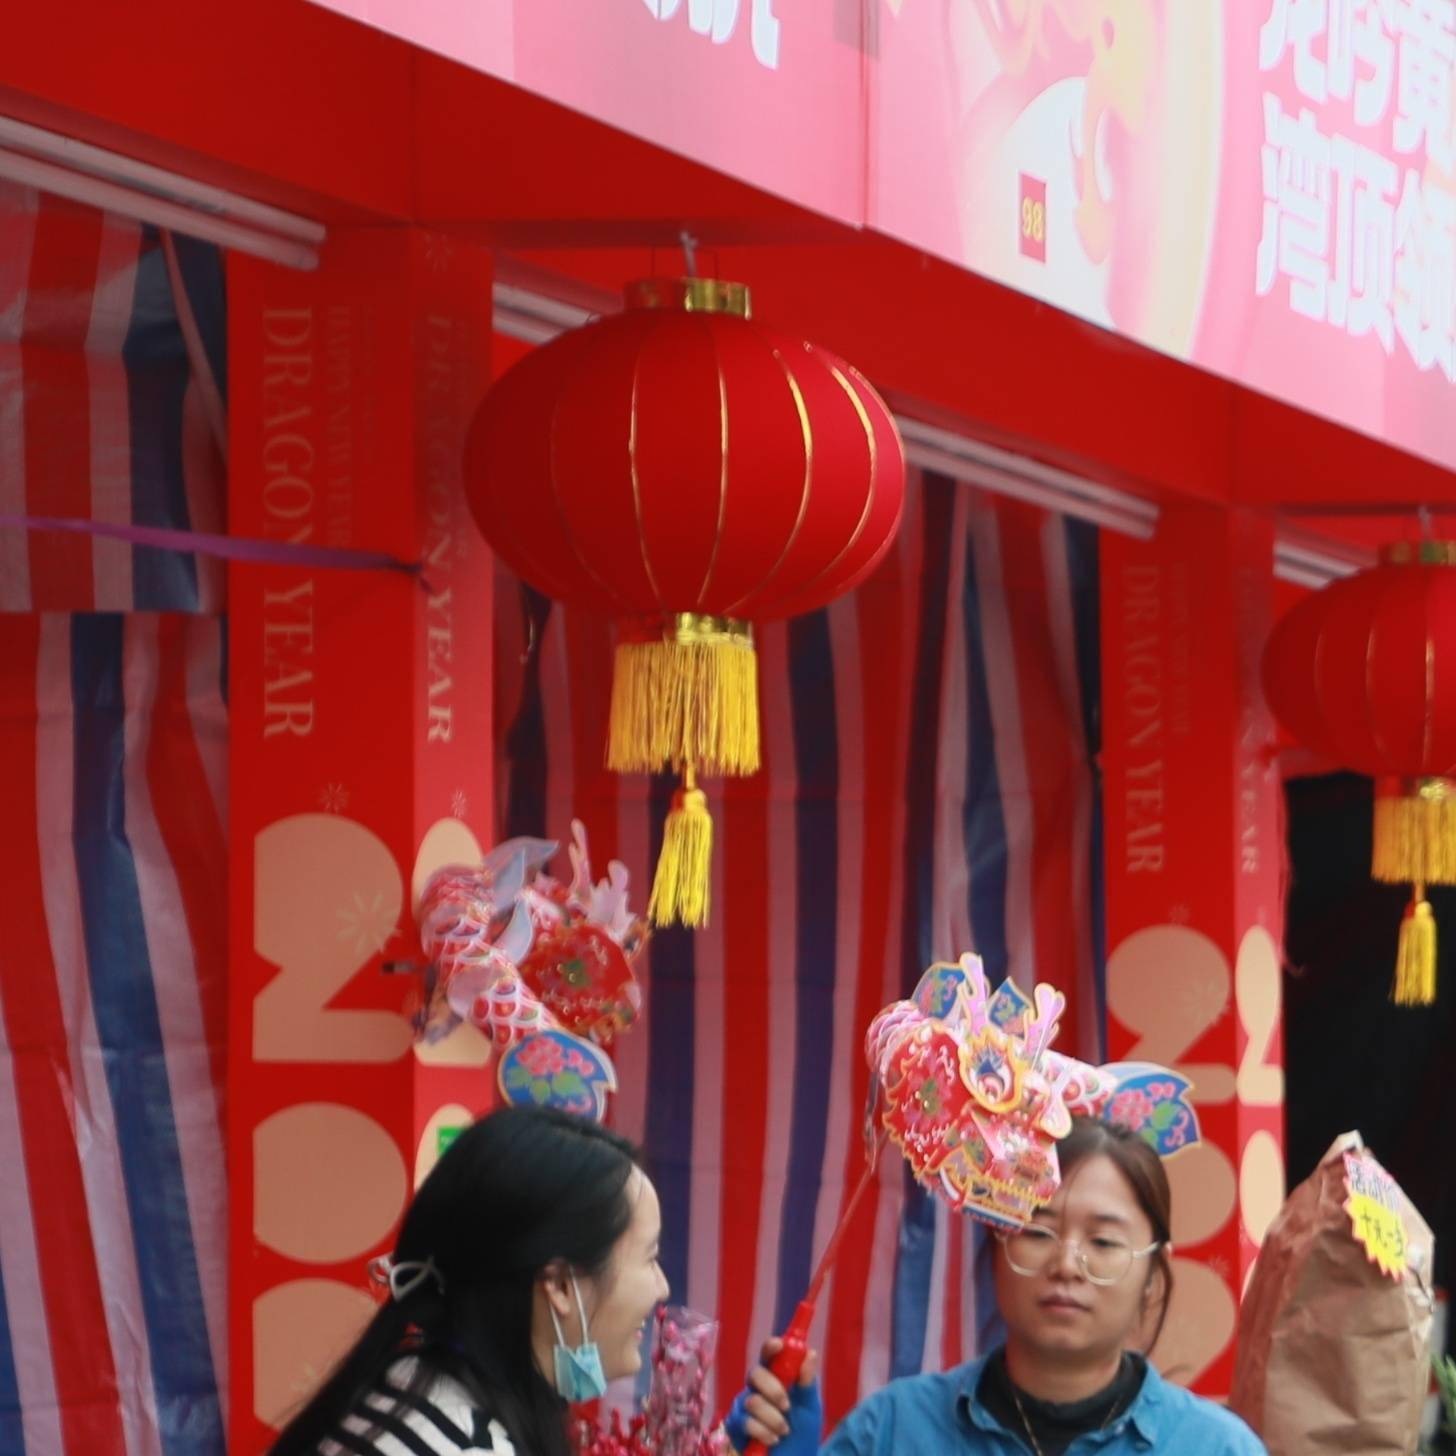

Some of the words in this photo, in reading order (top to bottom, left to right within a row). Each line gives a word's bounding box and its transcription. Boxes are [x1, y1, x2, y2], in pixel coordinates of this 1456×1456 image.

[263, 579, 315, 739] YEAR
[425, 588, 453, 745] YEAR
[1126, 758, 1166, 874] YEAR
